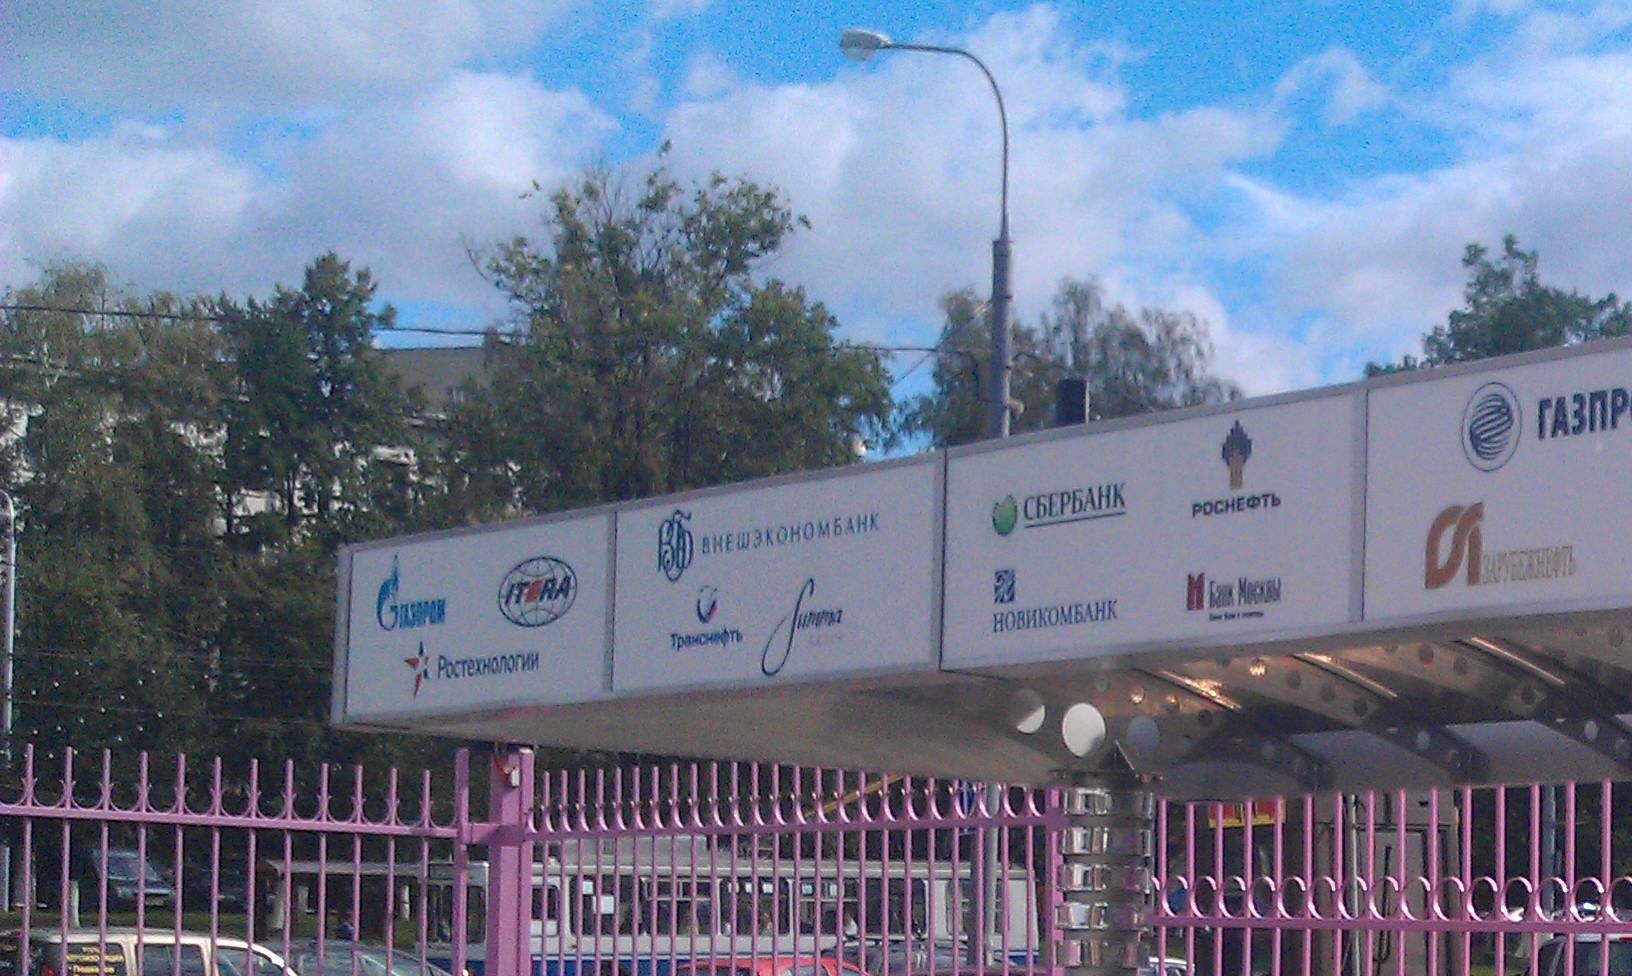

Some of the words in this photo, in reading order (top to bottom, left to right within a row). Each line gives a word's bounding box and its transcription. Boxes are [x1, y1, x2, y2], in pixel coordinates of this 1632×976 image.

[1023, 482, 1126, 521] СБЕРБАНК
[1192, 492, 1281, 518] РОСНЕФТЬ
[702, 512, 879, 554] ВНЕШЭКОНОМБАНК
[993, 600, 1117, 633] НОВИКОМБАНК
[671, 627, 742, 652] Транснефть
[438, 652, 539, 680] Ростехнологии
